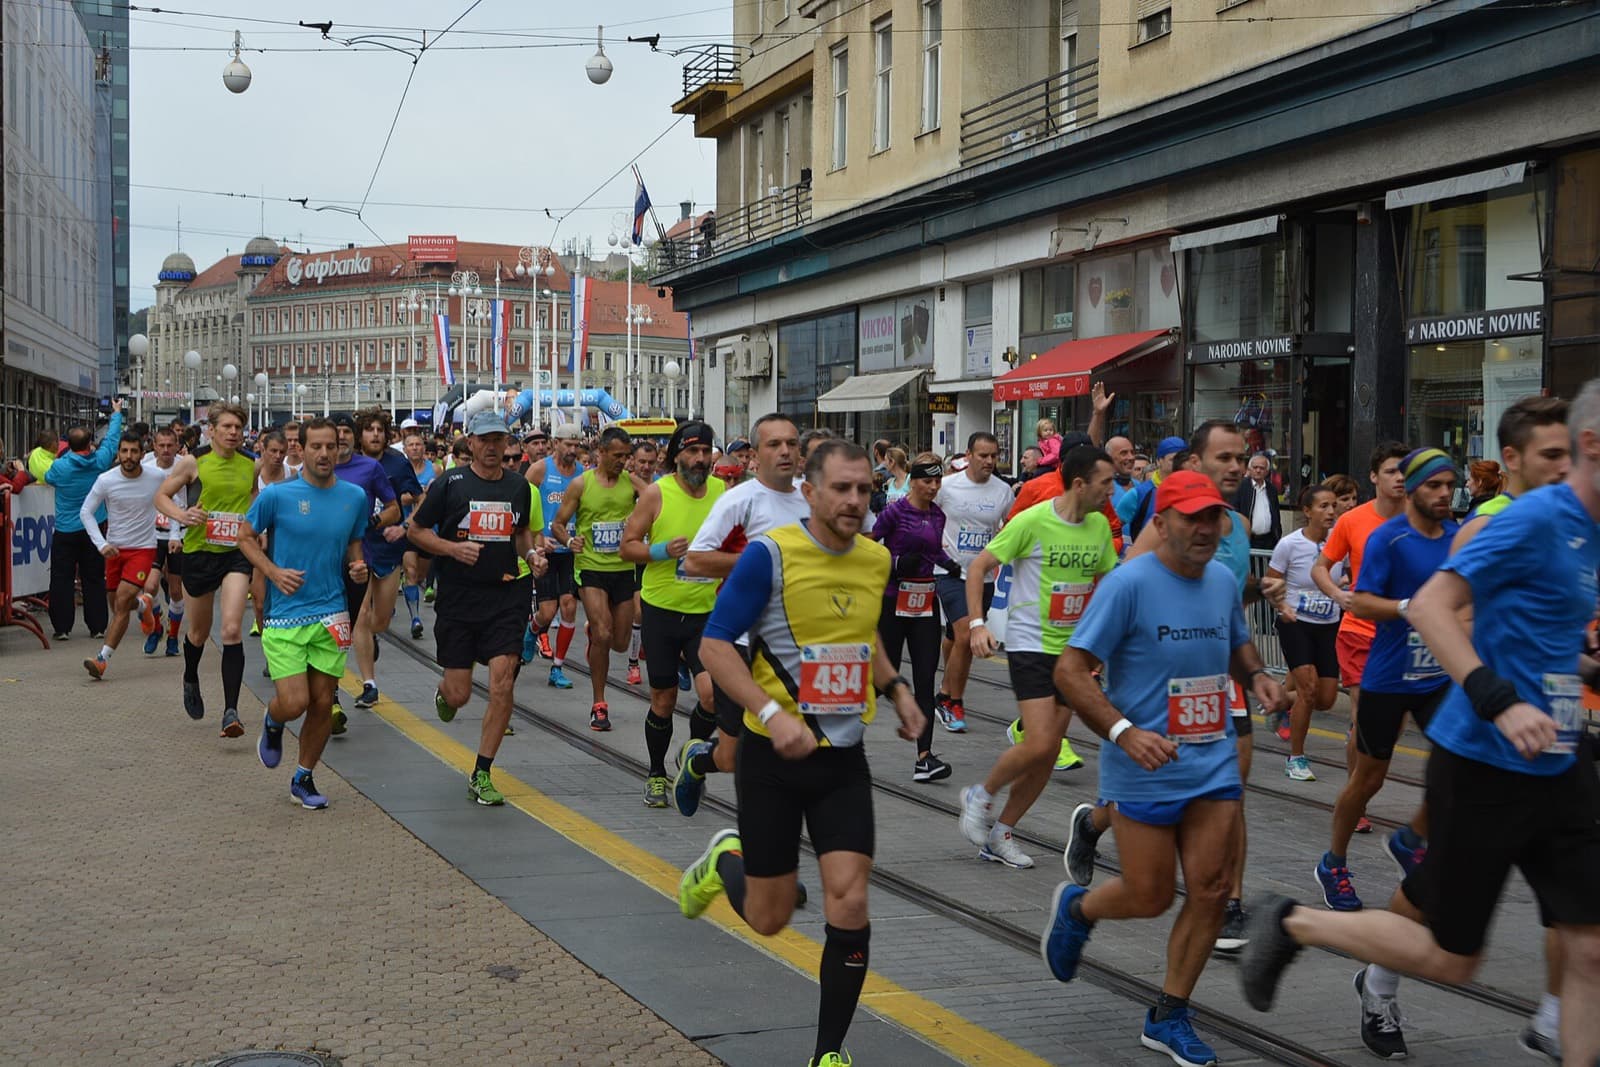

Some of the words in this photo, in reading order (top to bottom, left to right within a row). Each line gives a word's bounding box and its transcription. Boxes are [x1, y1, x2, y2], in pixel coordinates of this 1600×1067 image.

[410, 236, 454, 245] Internorm
[862, 316, 894, 340] VIKTOR
[1419, 317, 1485, 340] NARODNE
[1488, 311, 1541, 333] NOVINE
[1207, 342, 1253, 360] NARODNE
[1255, 337, 1291, 355] NOVINE
[212, 520, 239, 537] 258
[478, 512, 505, 531] 401
[960, 532, 990, 548] 2405
[907, 592, 927, 609] 60
[1062, 595, 1085, 615] 99
[1303, 598, 1332, 615] 1057
[812, 664, 862, 695] 434
[1178, 695, 1220, 726] 353
